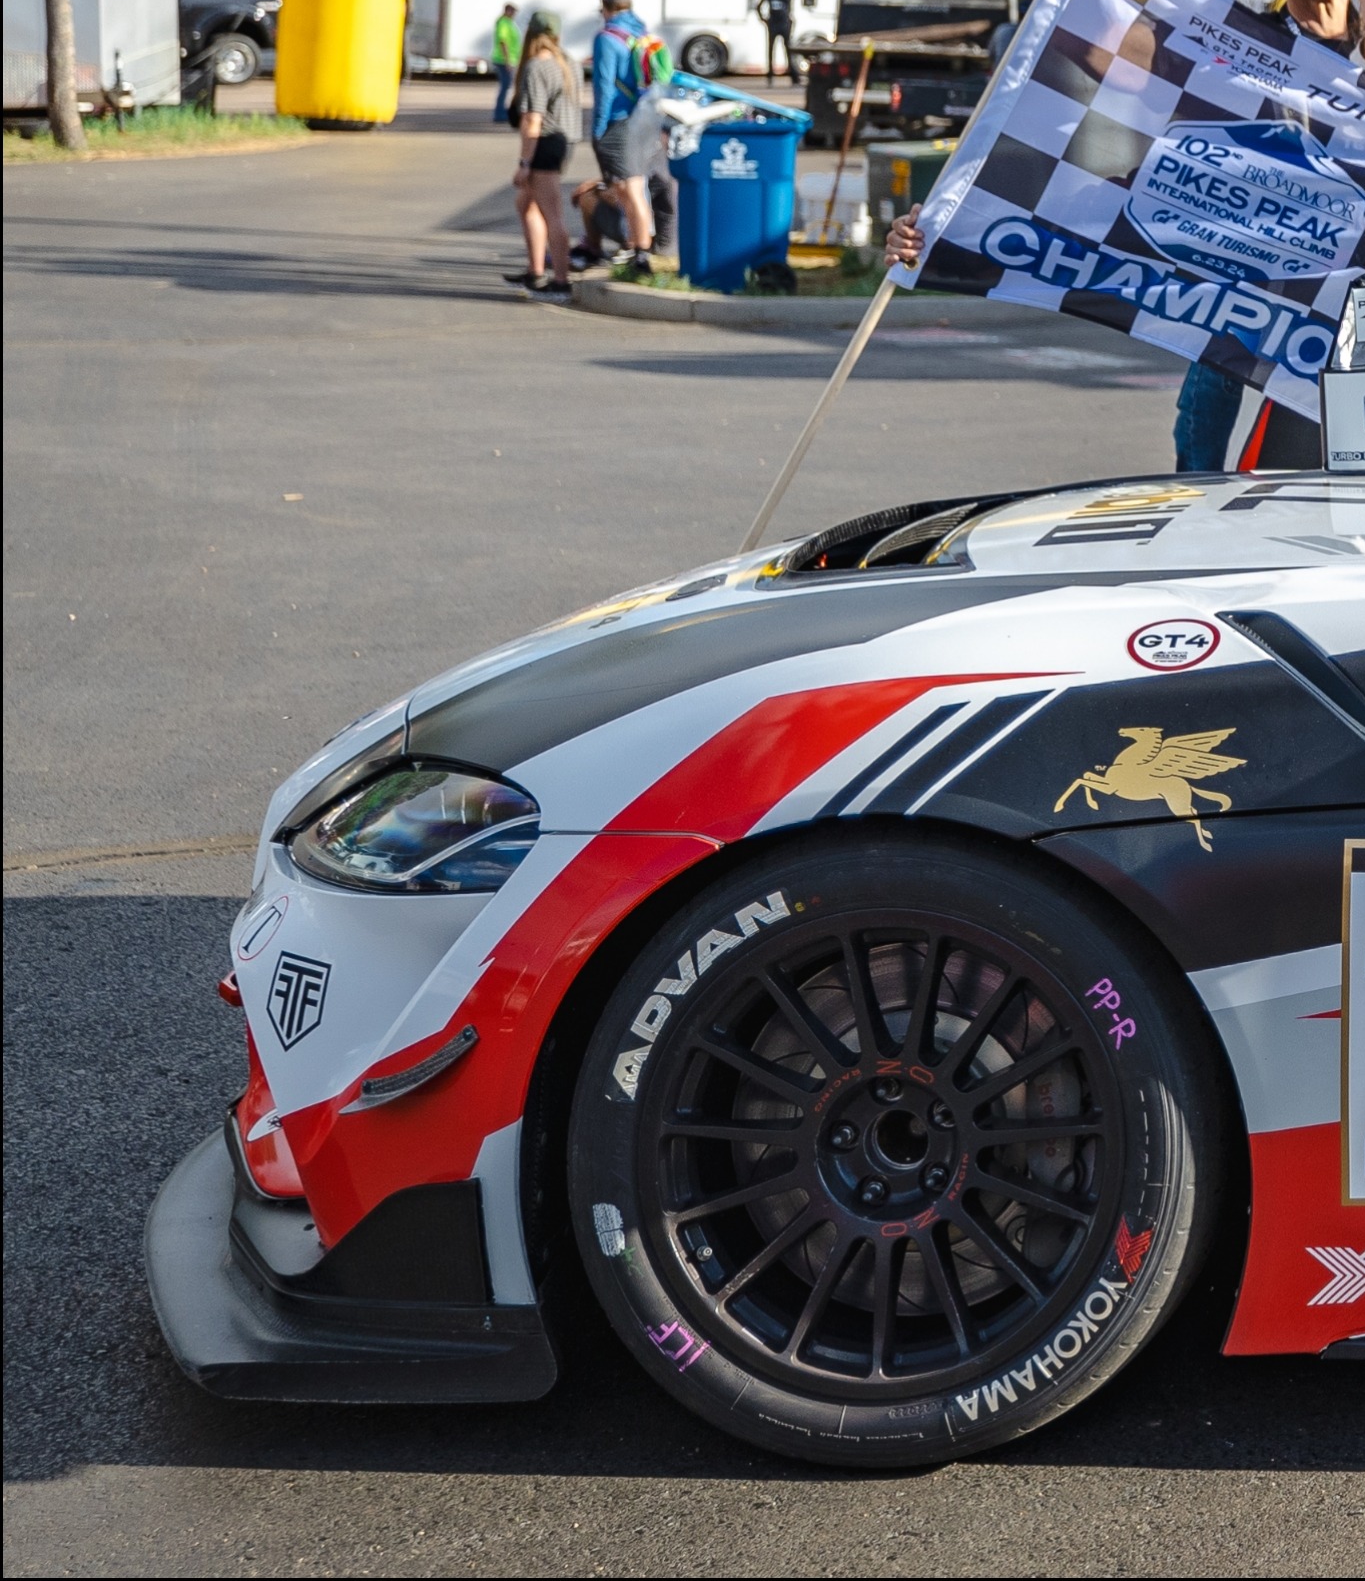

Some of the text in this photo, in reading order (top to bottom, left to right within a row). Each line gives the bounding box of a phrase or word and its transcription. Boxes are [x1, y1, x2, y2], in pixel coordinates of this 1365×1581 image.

[1189, 15, 1298, 79] PIKES PEAK
[1212, 45, 1236, 61] GT4
[1240, 57, 1291, 84] TROPHY
[1146, 177, 1337, 261] INTERNATIONAL HILL CLIMB
[1153, 154, 1348, 249] PIKES PEAK
[1243, 164, 1356, 221] BROADMOOR
[1177, 219, 1281, 265] GRAN TURISMO
[1191, 253, 1247, 279] 6.23.24
[1330, 451, 1362, 462] TURBO
[1138, 633, 1210, 649] GT4
[610, 890, 793, 1102] ADVAN
[1084, 978, 1137, 1051] PP-R
[957, 1276, 1124, 1423] YOKOHAMA
